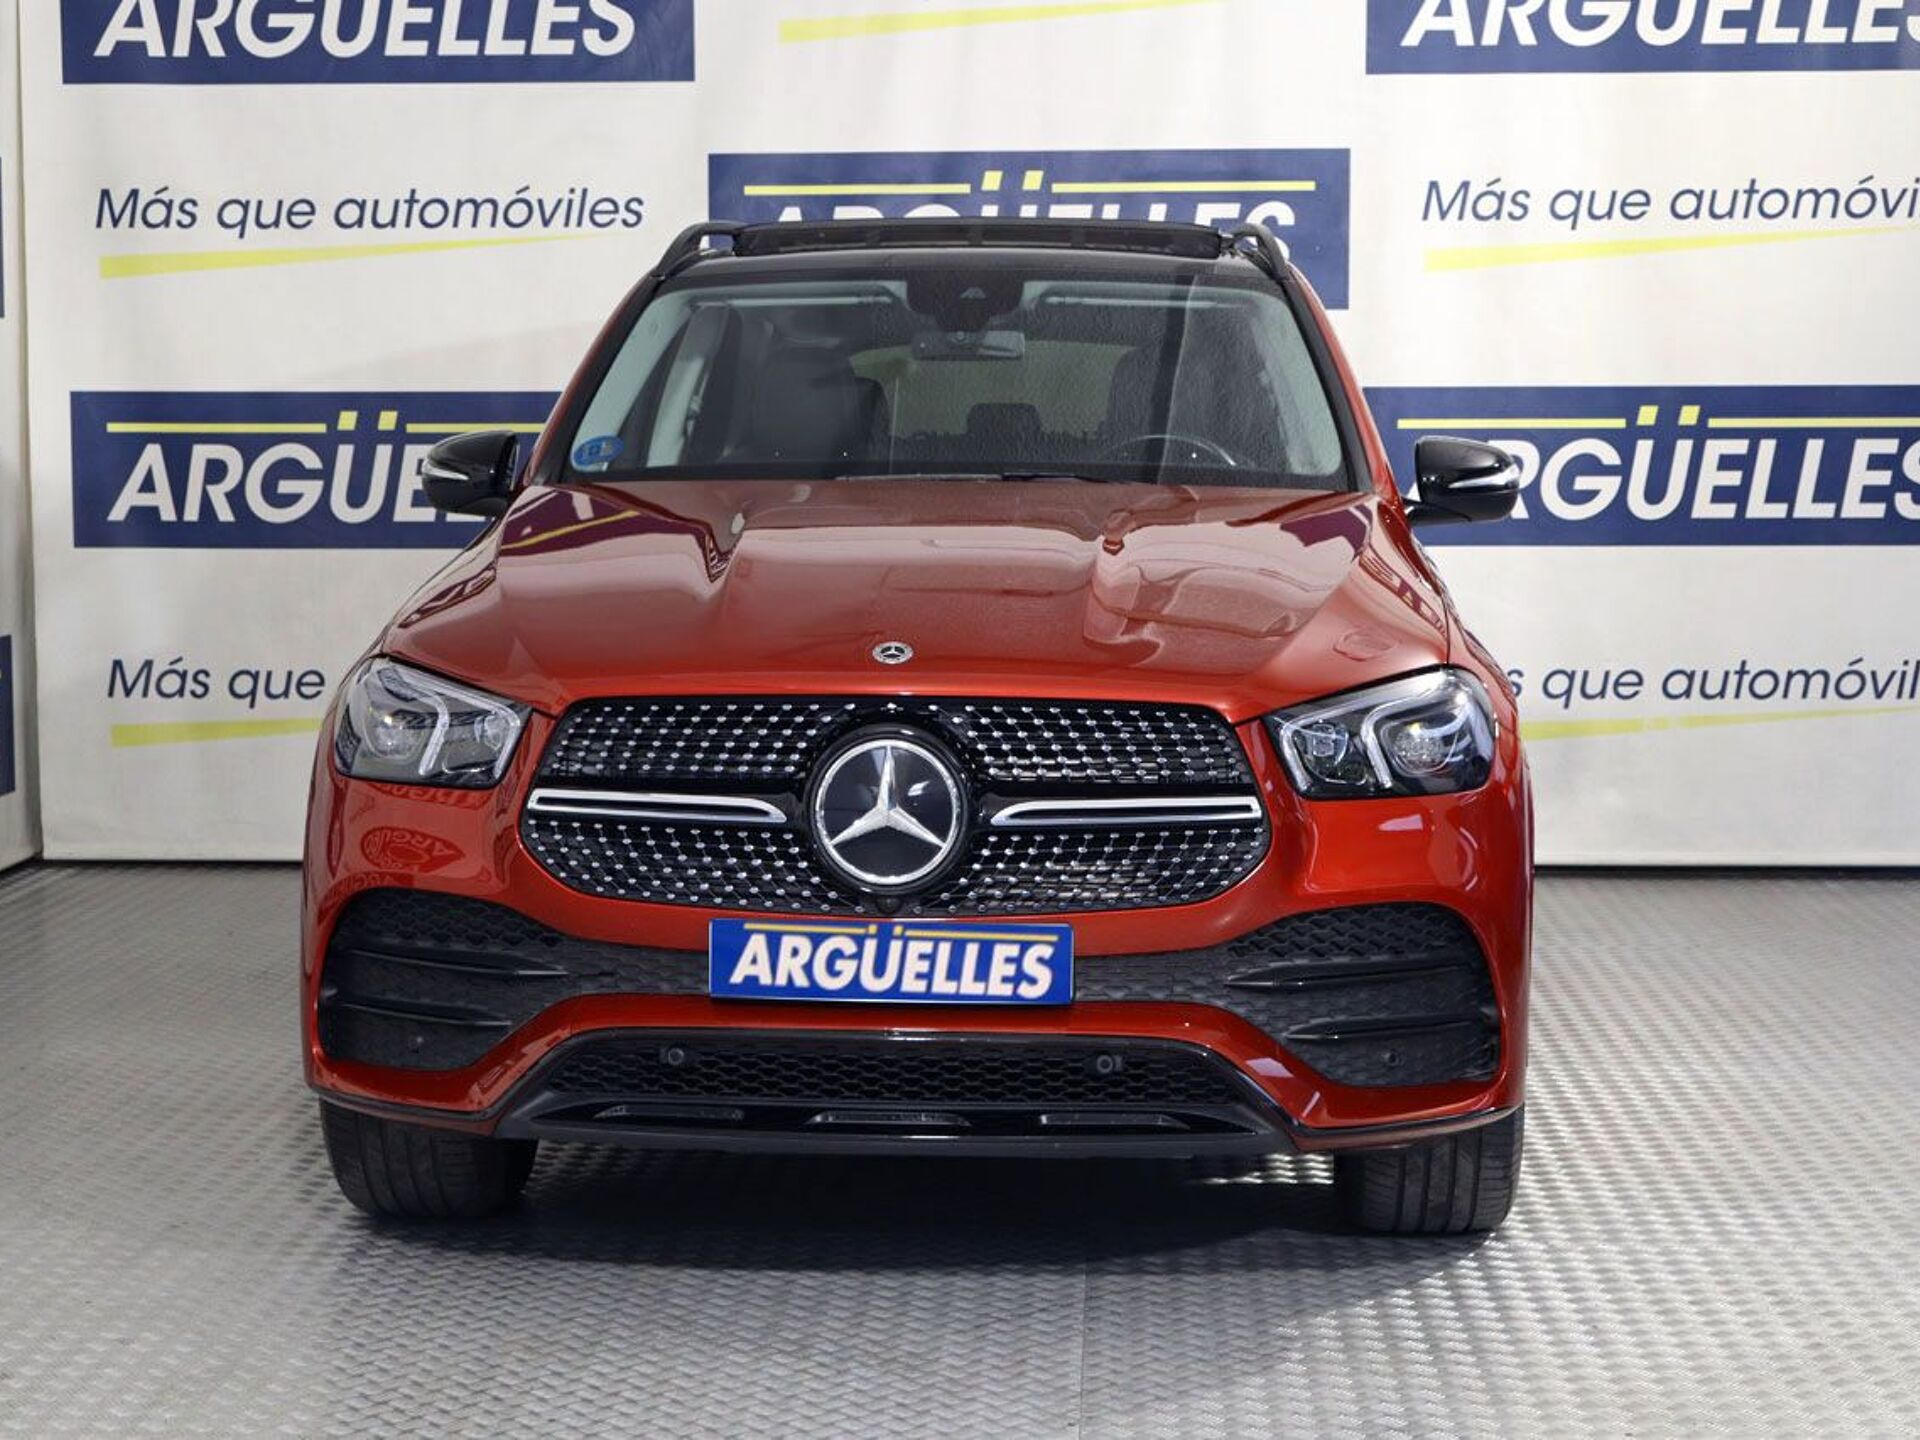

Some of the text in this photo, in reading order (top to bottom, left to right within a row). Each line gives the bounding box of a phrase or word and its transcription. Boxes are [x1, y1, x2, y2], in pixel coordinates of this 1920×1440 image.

[96, 185, 643, 239] Más que automóviles
[1422, 178, 1530, 221] Más
[1550, 189, 1651, 230] que
[107, 411, 486, 523] ARGÜE
[108, 656, 326, 708] Más que
[1542, 669, 1644, 709] que
[729, 924, 1054, 998] ARGÜELLES
